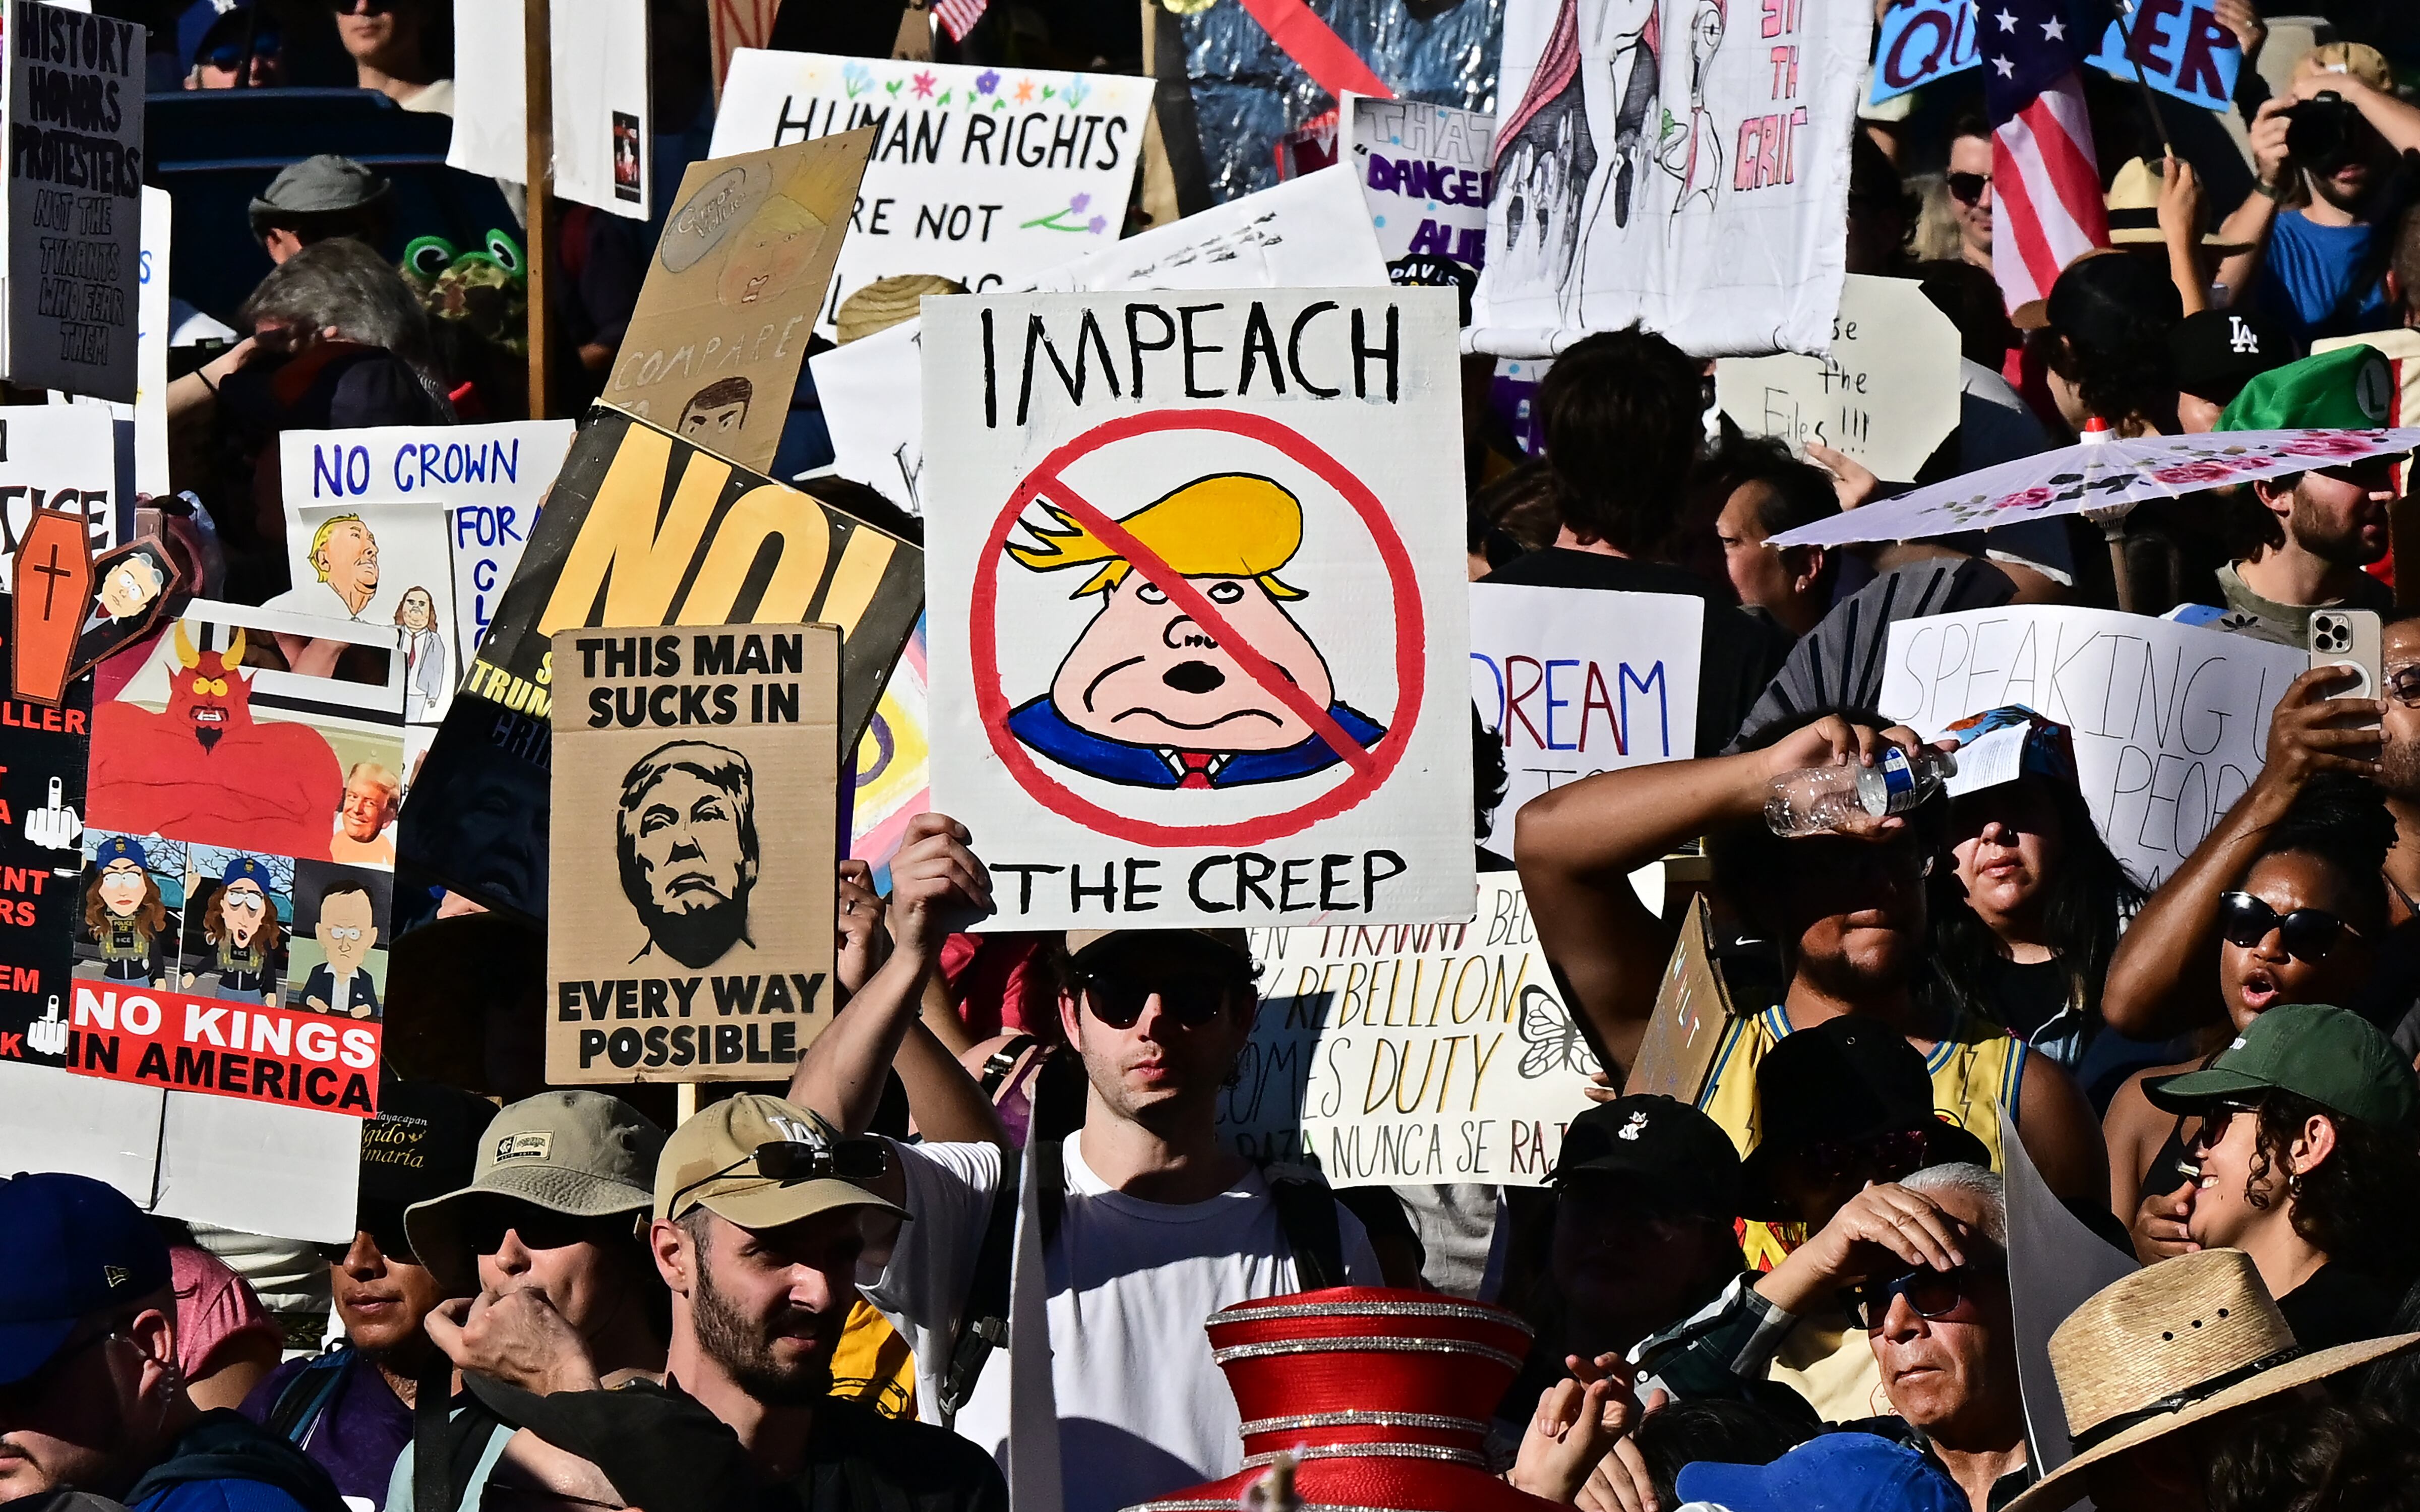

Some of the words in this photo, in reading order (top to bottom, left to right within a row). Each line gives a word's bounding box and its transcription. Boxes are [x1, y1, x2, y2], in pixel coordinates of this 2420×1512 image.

[19, 1, 134, 77] HISTORY
[29, 66, 122, 132] HONORS
[12, 121, 140, 198] PROTESTERS
[962, 112, 1126, 170] RIGHTS
[34, 189, 73, 232] NOT
[78, 197, 111, 235] THE
[852, 198, 895, 234] RE
[916, 204, 1002, 241] NOT
[40, 236, 120, 282] TYRANTS
[1390, 264, 1459, 286] DAVIS
[39, 277, 79, 321] WHO
[82, 284, 125, 326] FEAR
[60, 321, 109, 366] THEM
[1832, 318, 1857, 341] se
[2229, 316, 2259, 353] LA
[981, 301, 1399, 429] IMPEACH
[2366, 369, 2386, 413] L
[314, 444, 371, 498] NO
[394, 438, 518, 492] CROWN
[456, 505, 522, 550] FOR
[576, 635, 681, 678] THIS
[694, 634, 802, 676] MAN
[587, 684, 738, 728] SUCKS
[752, 683, 799, 723] IN
[1470, 655, 1669, 756] DREAM
[1894, 619, 2231, 755] SPEAKING
[989, 857, 1162, 914] THE
[1189, 850, 1408, 914] CREEP
[559, 977, 702, 1022] EVERY
[711, 973, 826, 1016] WAY
[1285, 953, 1531, 1030] REBELLION
[74, 988, 161, 1035] NO
[184, 1004, 376, 1068] KINGS
[580, 1021, 808, 1068] POSSIBLE.
[69, 1031, 119, 1074] IN
[135, 1043, 373, 1113] AMERICA
[1215, 1037, 1351, 1125] OMES
[1364, 1033, 1504, 1116] DUTY
[361, 1148, 424, 1168] maría
[768, 1116, 830, 1159] LA
[1333, 1124, 1442, 1179] NUNCA
[1457, 1120, 1496, 1174] SE
